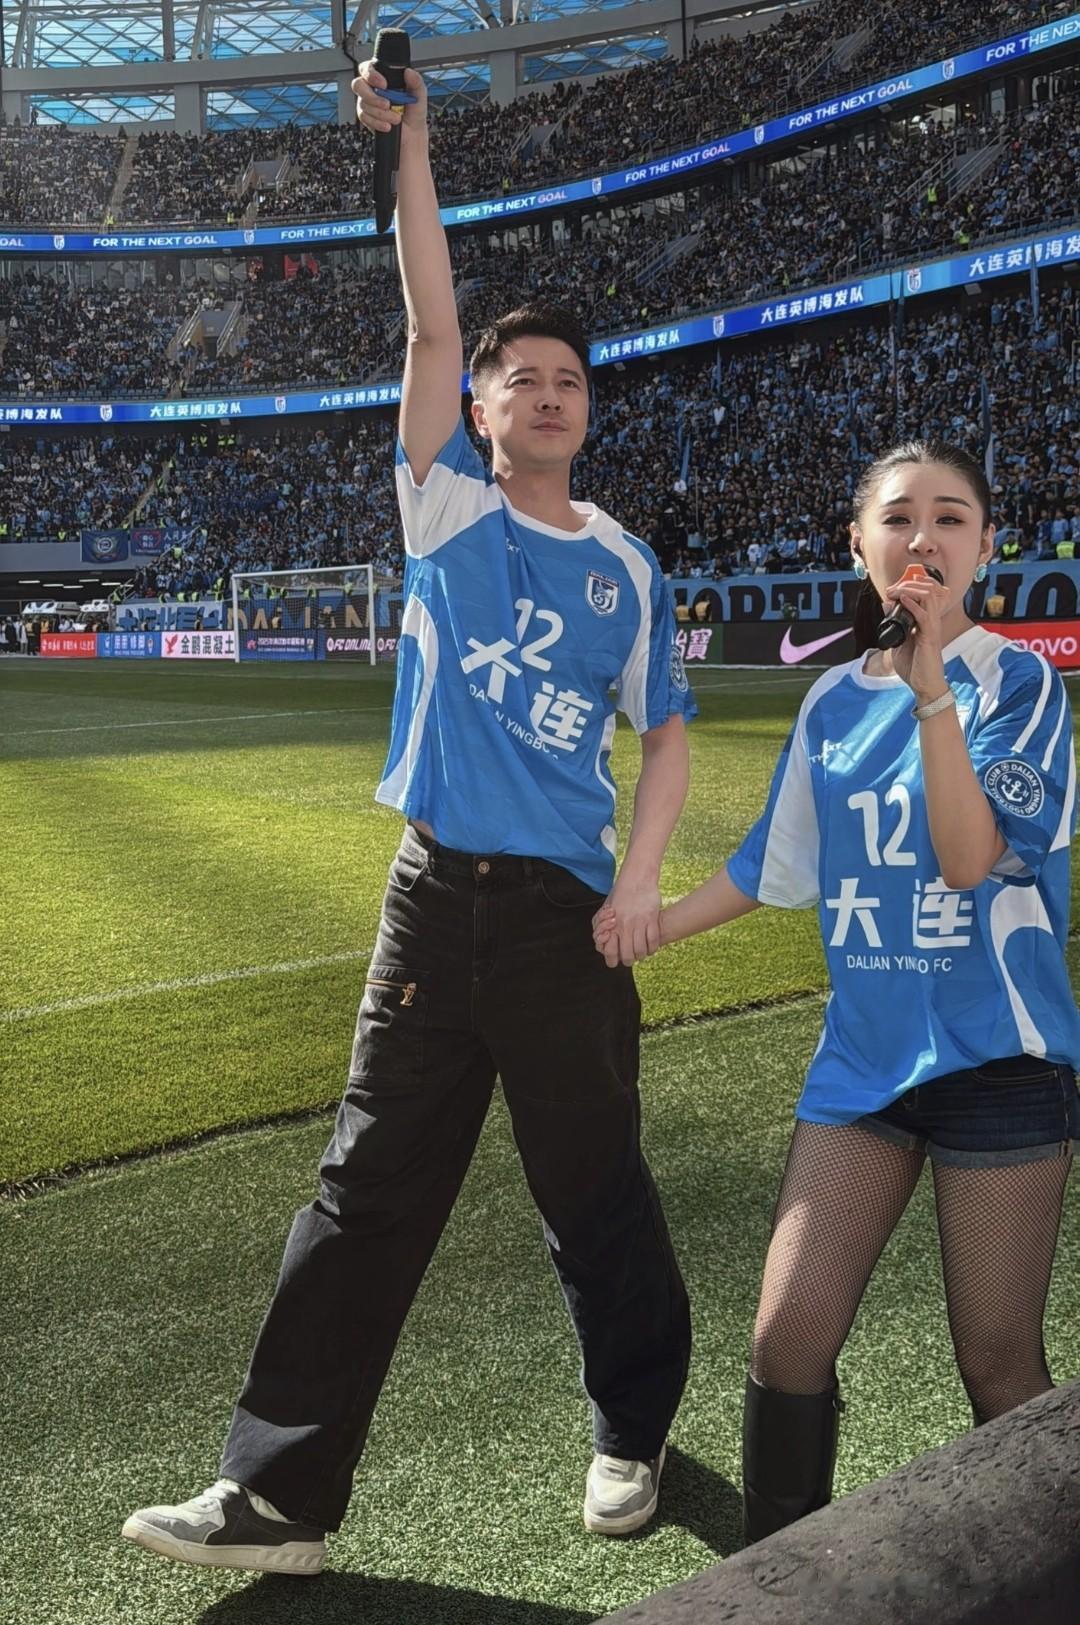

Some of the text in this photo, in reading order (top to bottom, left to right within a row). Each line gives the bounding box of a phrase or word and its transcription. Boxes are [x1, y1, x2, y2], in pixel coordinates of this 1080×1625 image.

[986, 42, 1015, 62] FOR
[1019, 30, 1049, 50] THE
[789, 78, 912, 129] FOR THE NEXT GOAL
[625, 142, 730, 183] FOR THE NEXT GOAL
[457, 190, 567, 220] FOR THE NEXT GOAL
[93, 235, 217, 247] FOR THE NEXT GOAL
[281, 229, 304, 240] FOR
[307, 227, 330, 237] THE
[332, 223, 364, 234] NEXT
[760, 285, 863, 324] 大连英博海发队
[599, 329, 680, 361] 大连英博海发队
[149, 402, 241, 418] 大连英博海发队
[319, 387, 400, 408] 大连英博海发队
[514, 598, 563, 672] 12
[1014, 636, 1077, 657] novo
[987, 767, 1002, 786] CLUB
[1011, 764, 1038, 787] DALIAN
[847, 783, 917, 866] 12
[825, 876, 974, 949] 大连
[846, 954, 952, 974] DALIAN YINO FC
